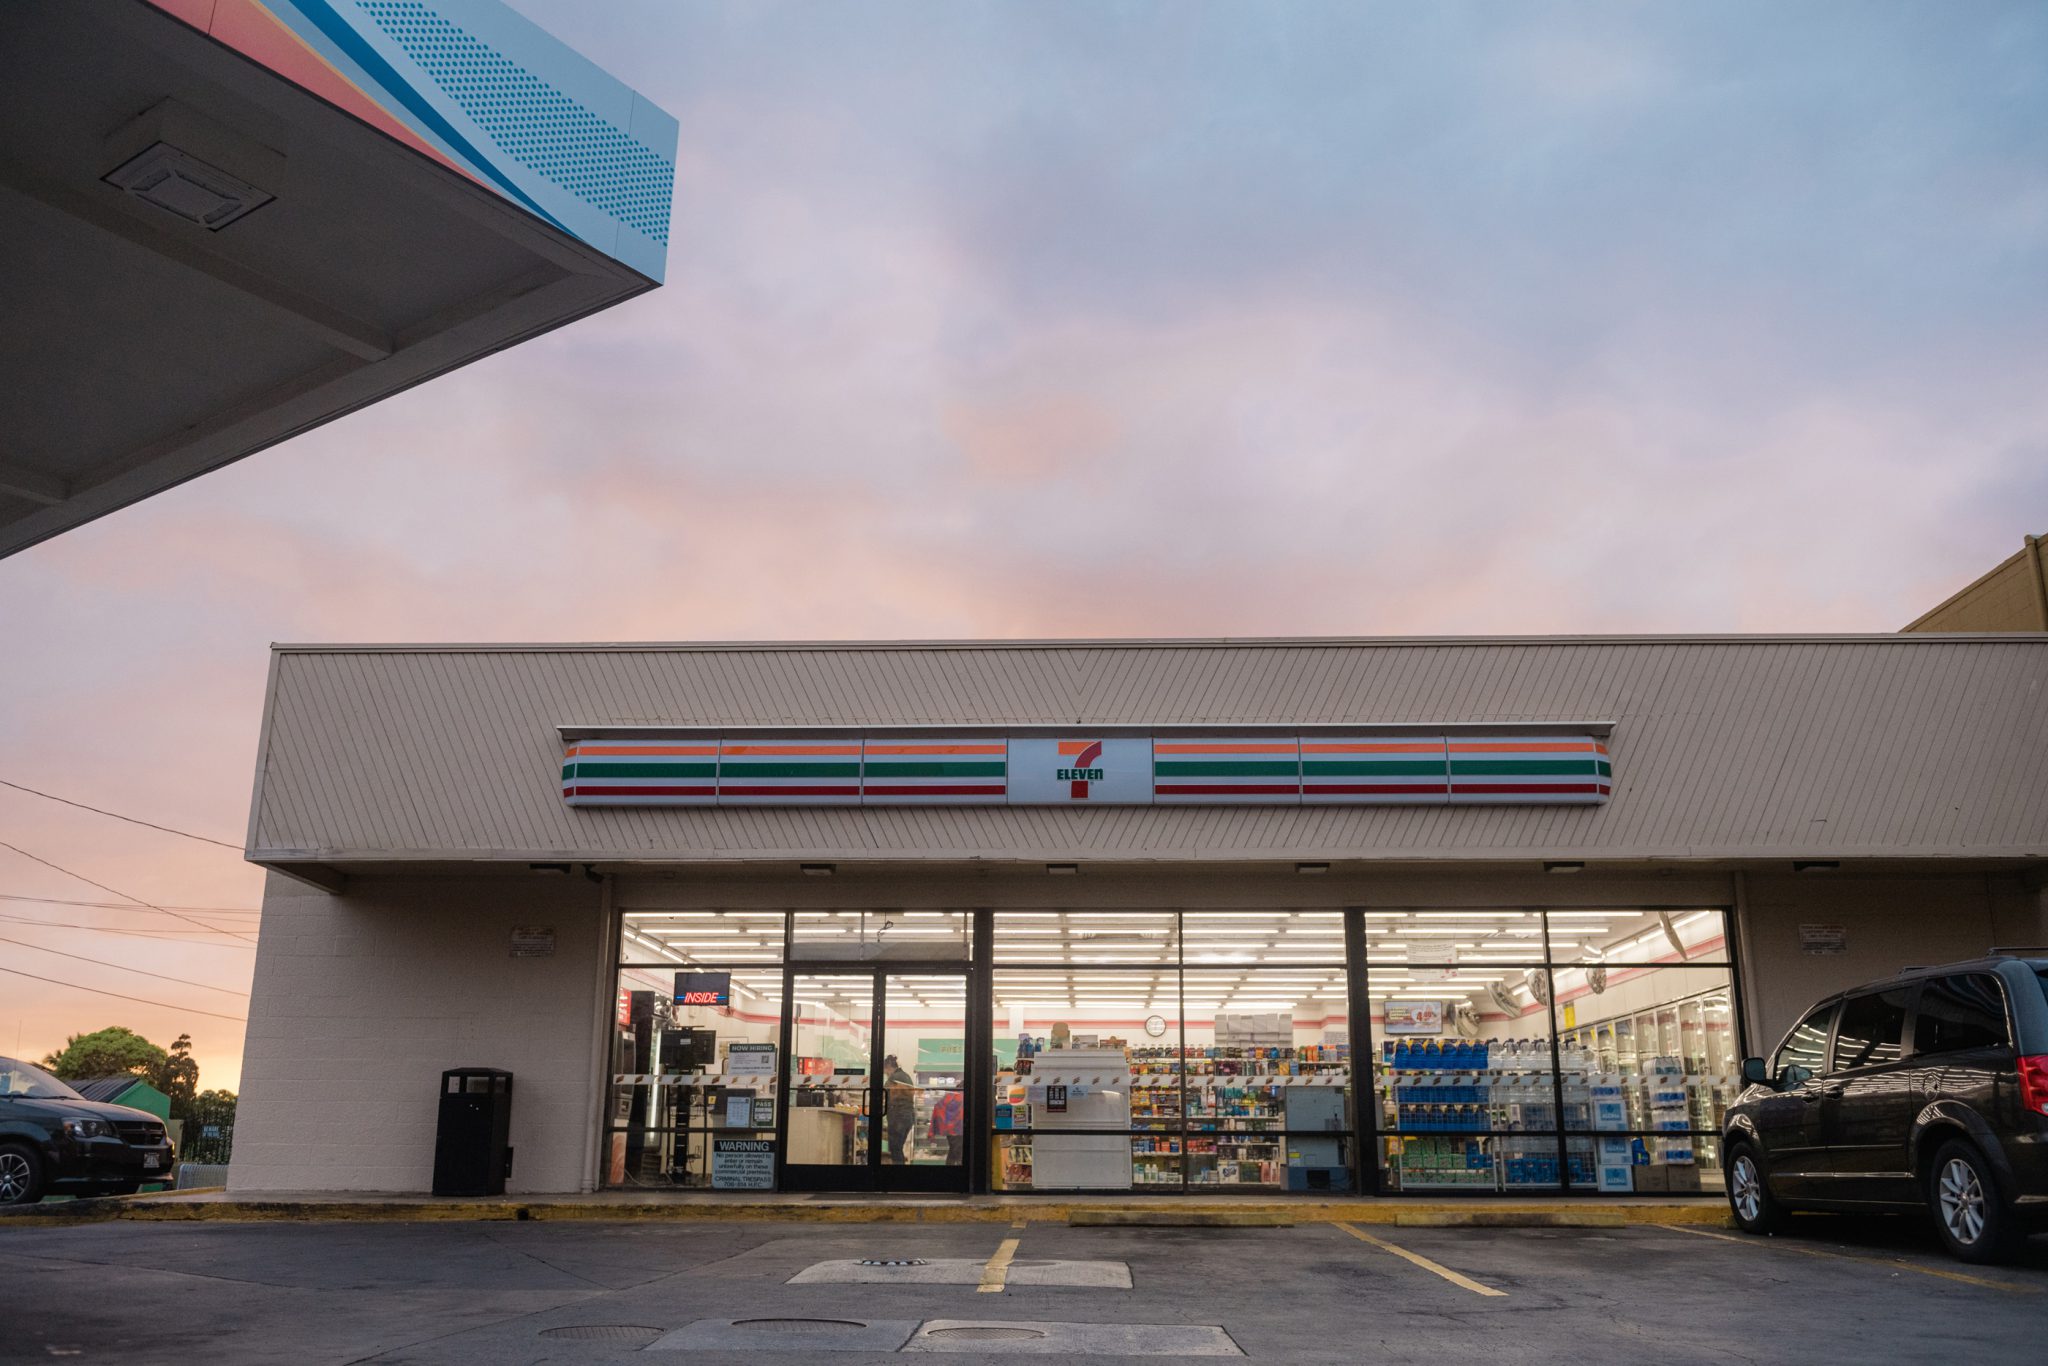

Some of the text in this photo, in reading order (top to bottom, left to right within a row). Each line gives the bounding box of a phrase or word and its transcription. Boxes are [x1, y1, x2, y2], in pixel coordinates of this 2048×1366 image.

[1058, 740, 1102, 798] 7
[684, 992, 719, 1003] INSIDE
[720, 1141, 770, 1151] WARNING
